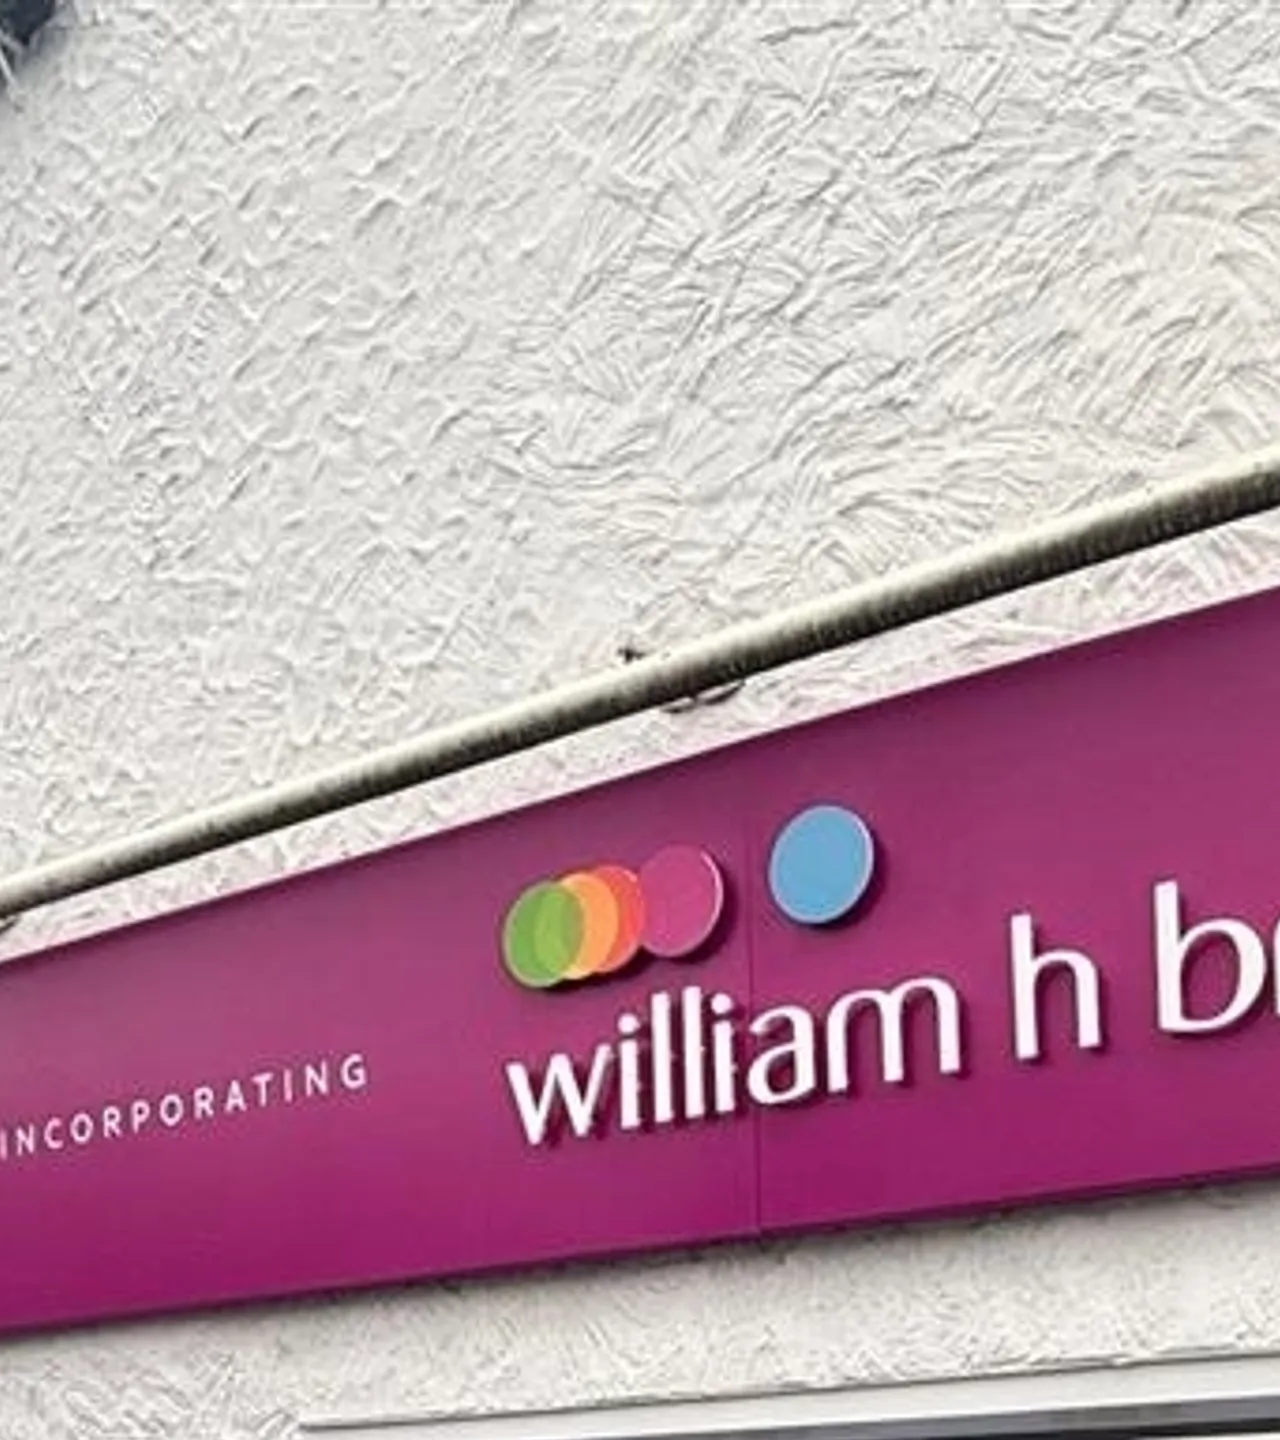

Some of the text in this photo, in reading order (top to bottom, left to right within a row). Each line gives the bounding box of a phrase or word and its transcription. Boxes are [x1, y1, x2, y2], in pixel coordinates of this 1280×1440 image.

[0, 1052, 370, 1158] INCORPORATING
[506, 974, 961, 1145] william
[1010, 913, 1101, 1060] h
